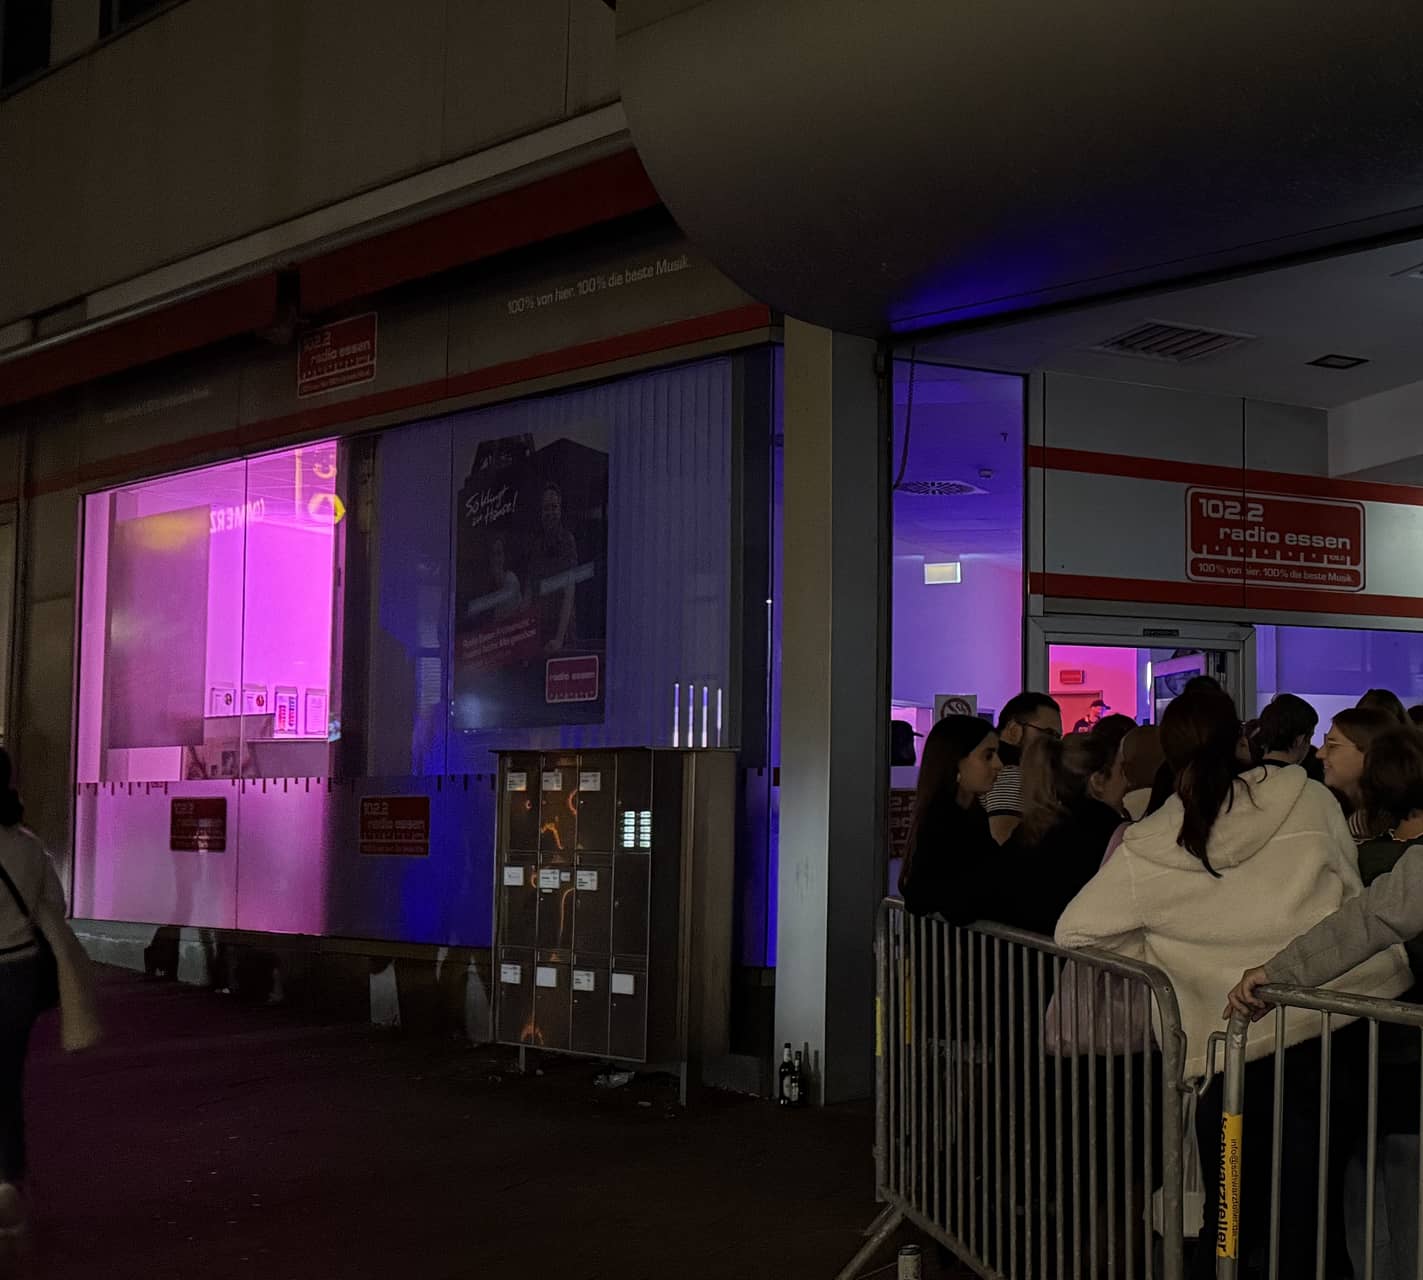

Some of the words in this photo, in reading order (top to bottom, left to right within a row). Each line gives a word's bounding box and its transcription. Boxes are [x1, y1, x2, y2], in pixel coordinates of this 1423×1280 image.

[1198, 499, 1265, 523] 102.2
[1219, 526, 1280, 544] radio
[1284, 532, 1351, 550] essen
